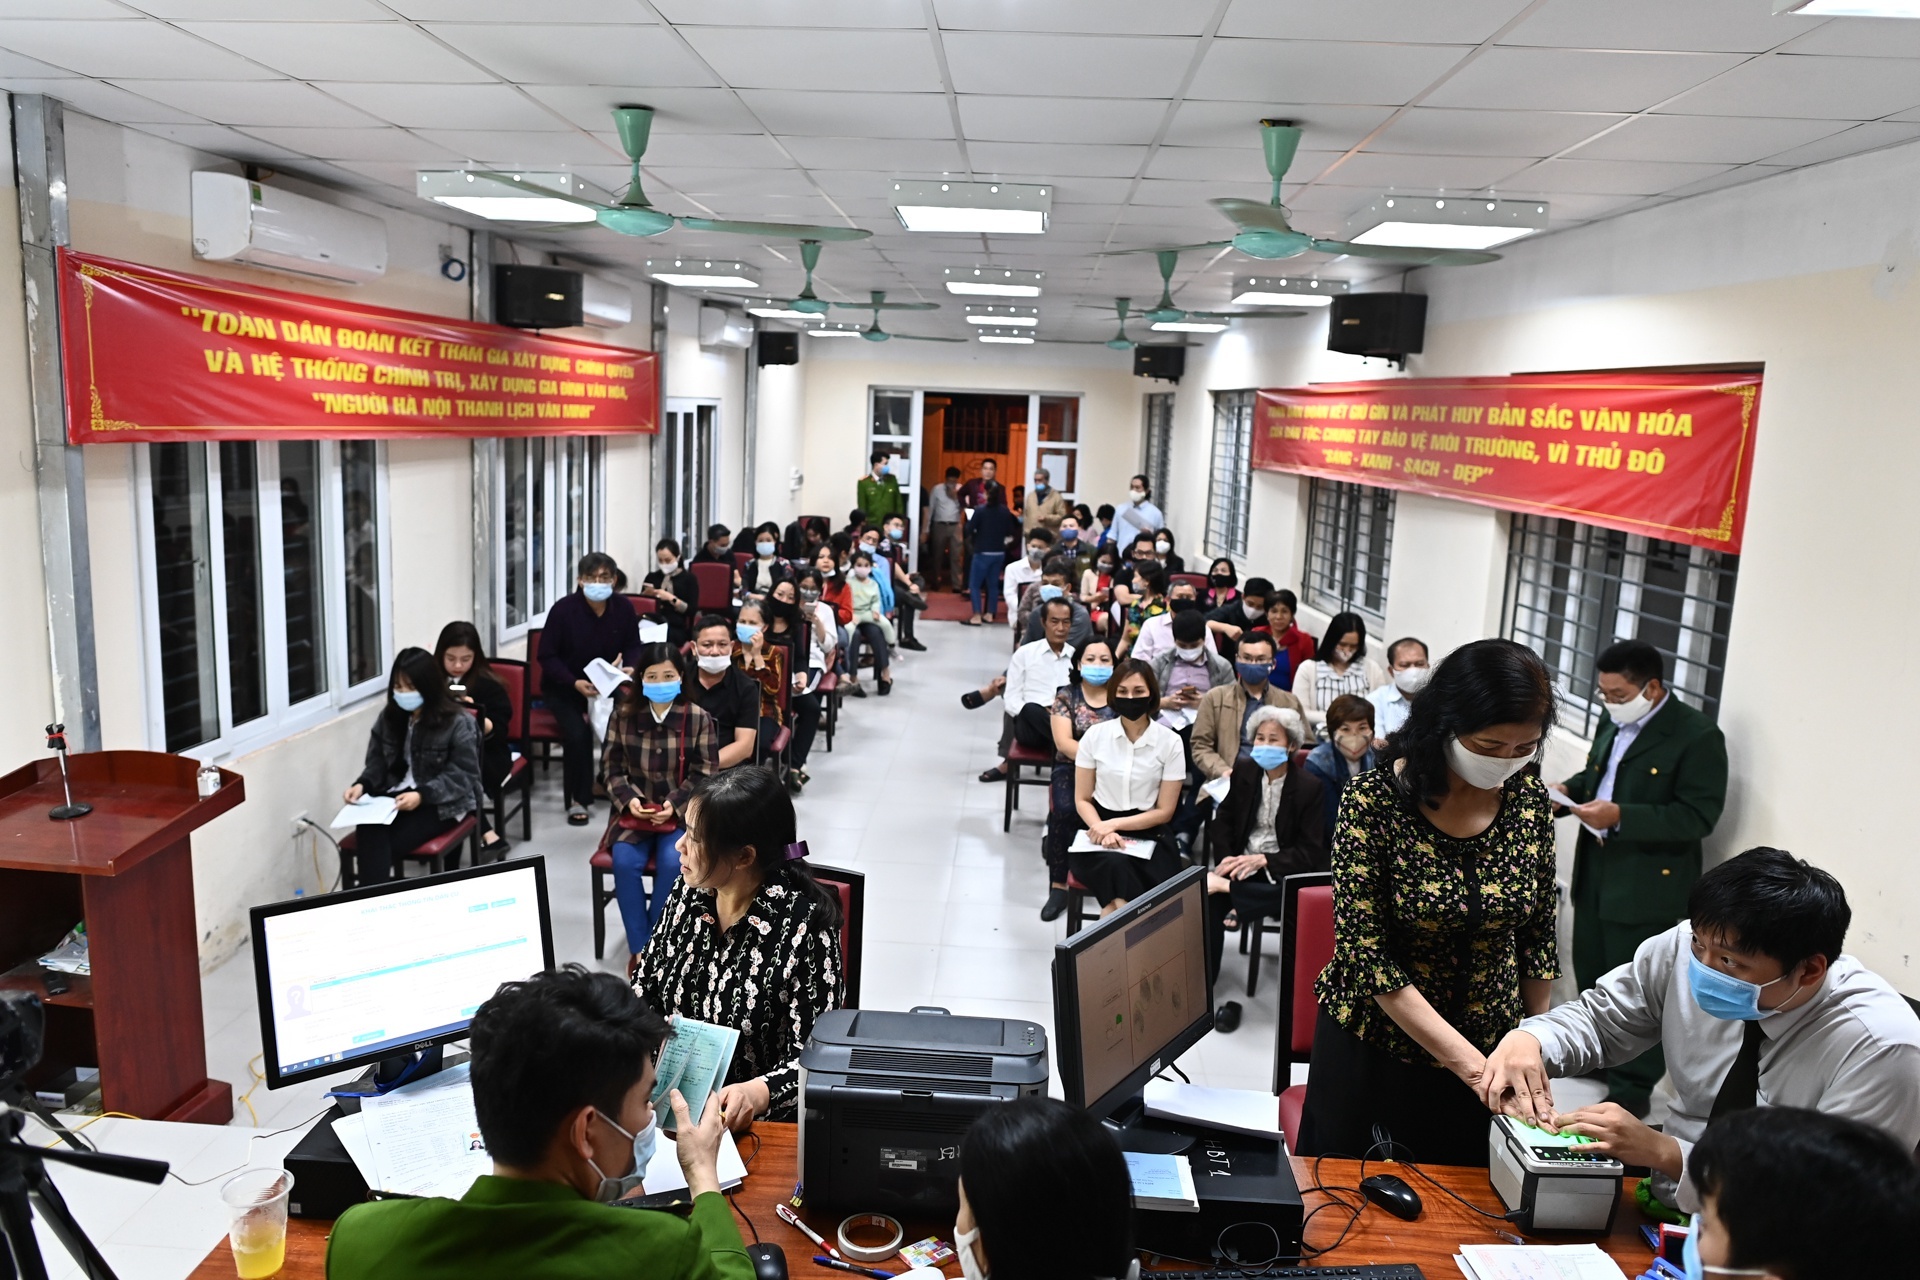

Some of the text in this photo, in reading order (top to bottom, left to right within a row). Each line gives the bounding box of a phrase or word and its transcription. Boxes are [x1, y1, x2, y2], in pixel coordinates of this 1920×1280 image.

[280, 319, 332, 347] DÂN
[336, 327, 396, 354] ĐOÀN
[400, 335, 434, 357] KẾT
[439, 341, 483, 363] THAM
[487, 348, 509, 365] GIA
[512, 350, 537, 369] XÂY
[204, 347, 245, 374] VÀ
[251, 351, 285, 382] HỆ
[290, 356, 368, 383] THỐNG
[373, 364, 430, 387] CHÍNH
[434, 370, 465, 393] TRỊ,
[470, 372, 498, 392] XÂY
[539, 379, 558, 395] GIA
[392, 393, 418, 415] HÀ
[422, 396, 451, 420] NỘI
[455, 399, 503, 417] THANH
[507, 402, 534, 421] LỊCH
[1392, 403, 1408, 421] VÀ
[1411, 402, 1447, 422] PHÁT
[1451, 406, 1484, 424] HUY
[1487, 402, 1526, 427] BẢN
[1530, 403, 1574, 430] SẮC
[1579, 406, 1631, 433] VĂN
[1636, 408, 1693, 437] HÓA
[1358, 428, 1380, 445] TAY
[1381, 427, 1407, 447] BẢO
[1411, 429, 1427, 452] VỆ
[1430, 431, 1460, 452] MÔI
[1547, 440, 1569, 464] VÌ
[1575, 441, 1622, 470] THỦ
[1627, 448, 1666, 474] ĐÔ
[1360, 452, 1393, 470] XANH
[414, 1040, 434, 1050] DELL
